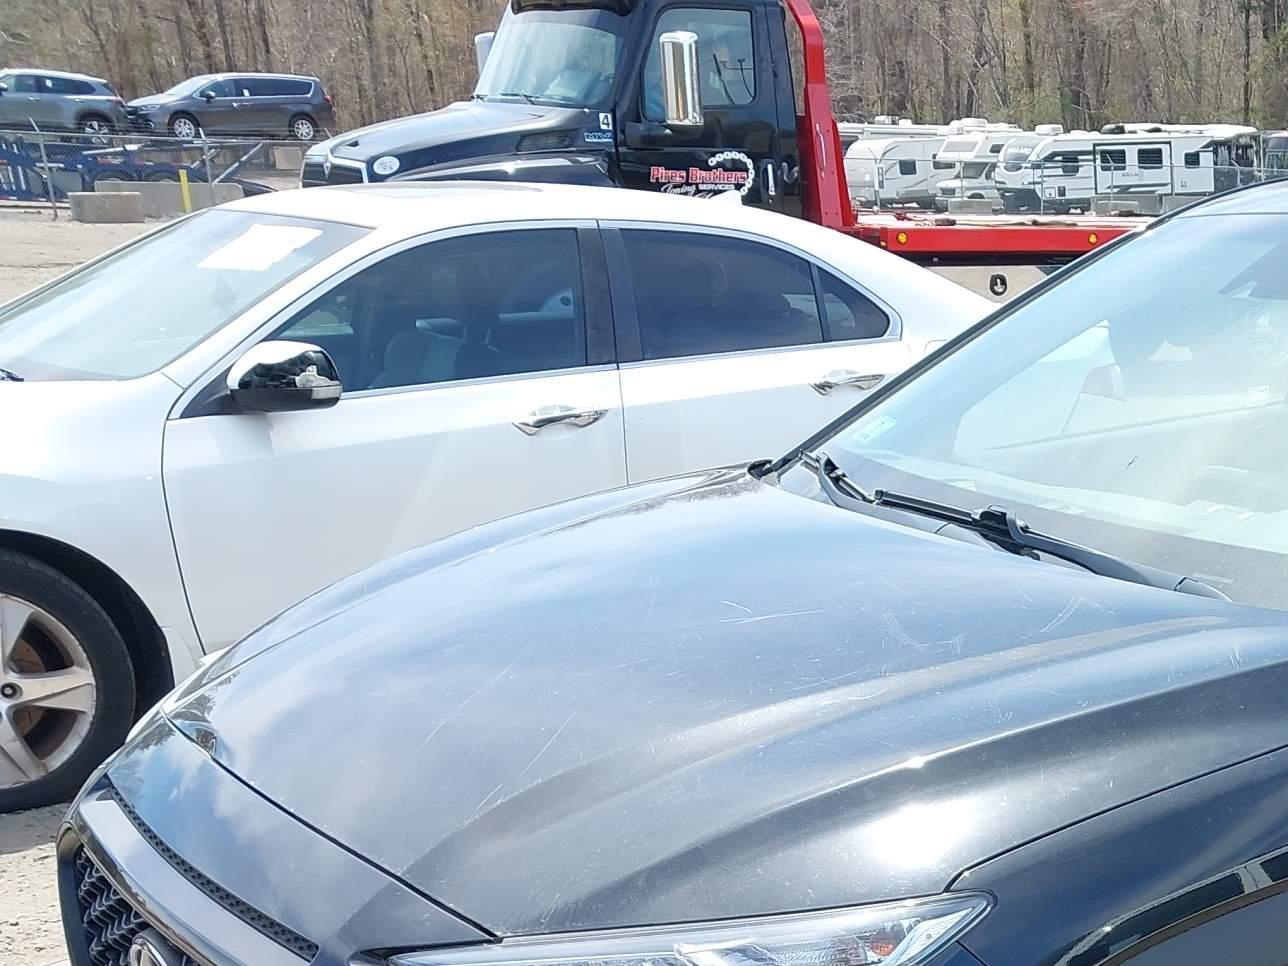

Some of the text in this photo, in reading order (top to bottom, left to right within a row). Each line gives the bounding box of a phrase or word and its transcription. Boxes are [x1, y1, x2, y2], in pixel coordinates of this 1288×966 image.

[601, 114, 611, 129] 4
[650, 166, 748, 184] Pires Brothers
